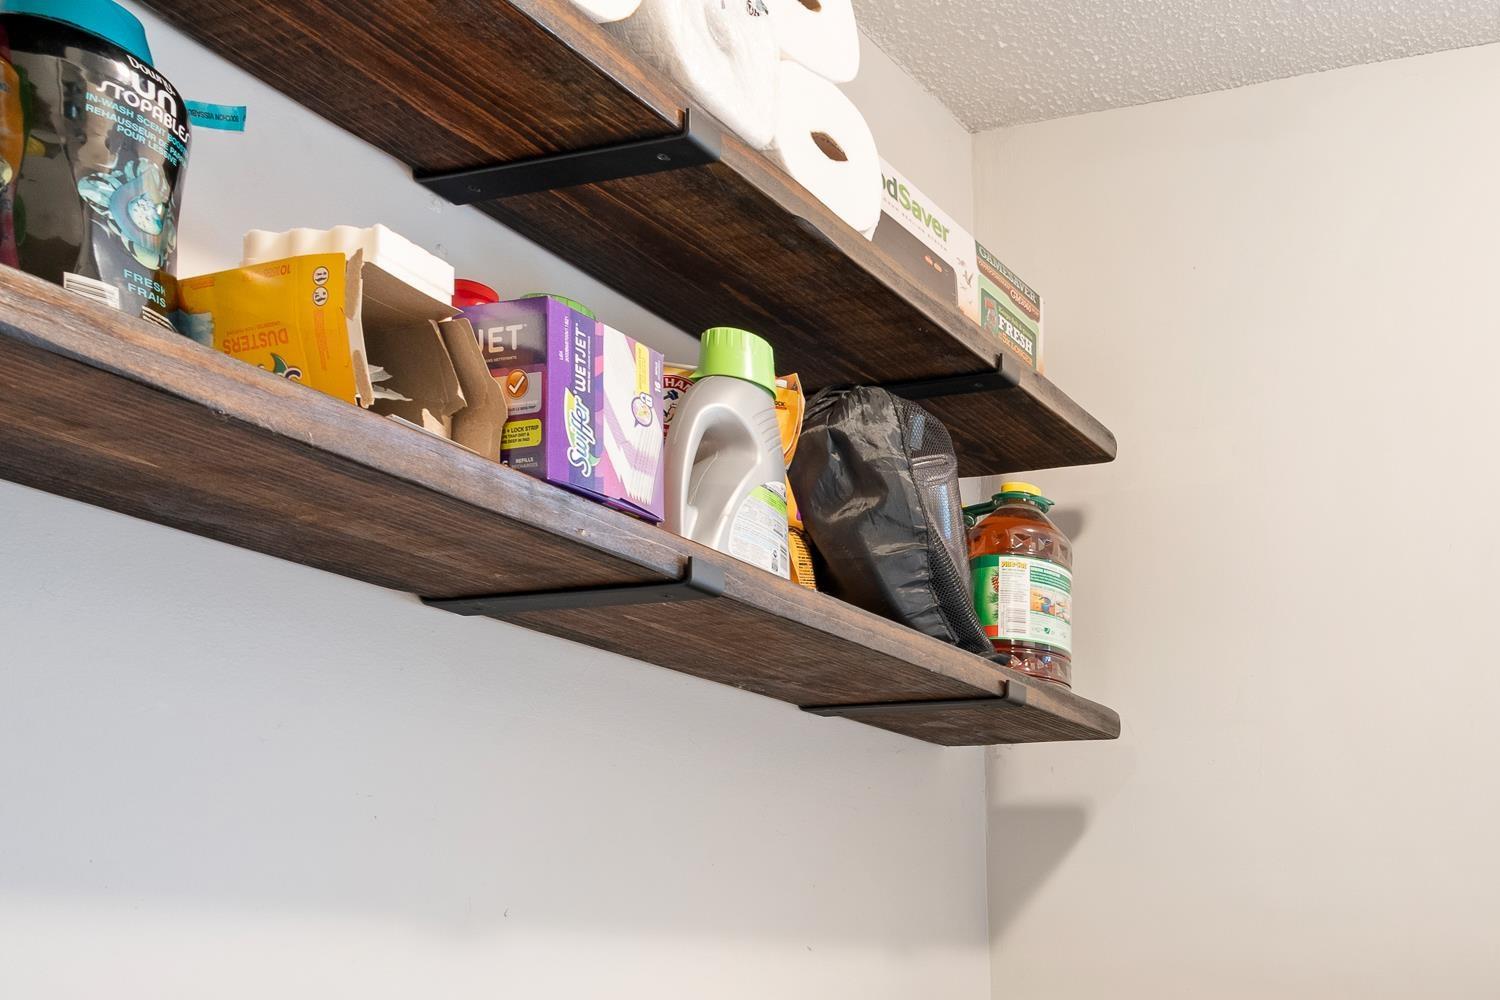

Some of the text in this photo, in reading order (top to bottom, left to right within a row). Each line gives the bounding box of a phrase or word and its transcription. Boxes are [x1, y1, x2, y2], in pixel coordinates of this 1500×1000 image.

[126, 54, 174, 96] Downy
[85, 92, 134, 118] IN-WASH
[137, 115, 167, 137] SCENT
[85, 104, 157, 142] REHAUSSEUR
[116, 126, 147, 145] POUR
[127, 283, 167, 308] FRAIS
[222, 328, 289, 355] DUSTERS
[998, 313, 1033, 356] FRESH
[566, 324, 596, 479] Swiffer WETJET
